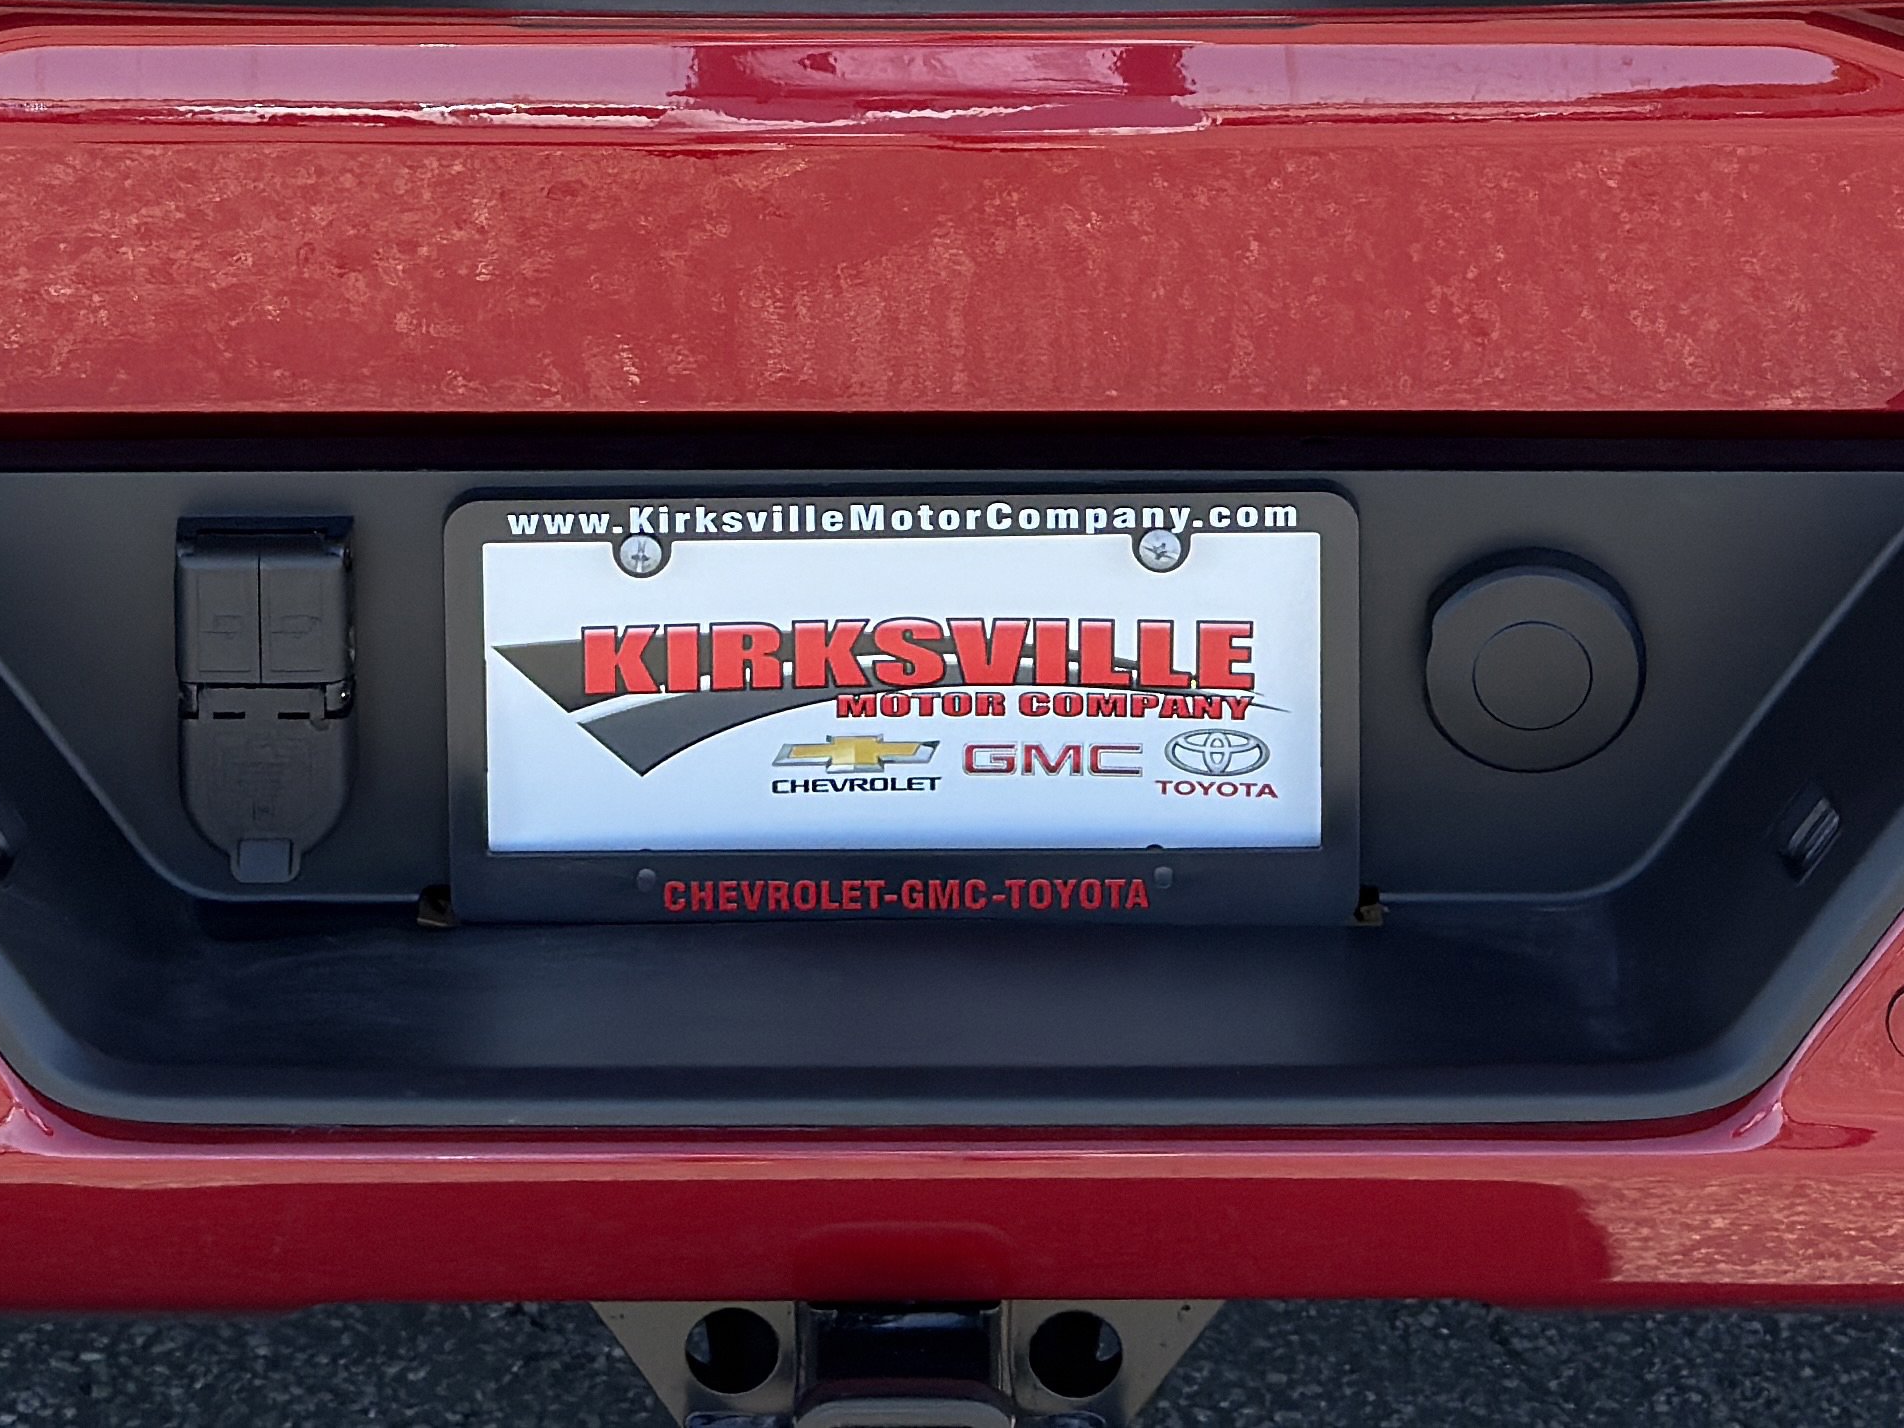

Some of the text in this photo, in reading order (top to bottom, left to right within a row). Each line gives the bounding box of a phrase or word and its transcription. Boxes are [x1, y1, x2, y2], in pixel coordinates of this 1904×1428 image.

[507, 502, 1297, 535] www.KirksvilleMotorCompany.com
[581, 617, 1254, 696] KIRKSVILLE
[836, 692, 1253, 721] MOTOR COMPANY
[961, 742, 1143, 777] GMC
[771, 776, 942, 794] CHEVROLET
[1154, 780, 1278, 799] TOYOTA
[663, 879, 1150, 912] CHEVROLET-GMC-TOYOTA
